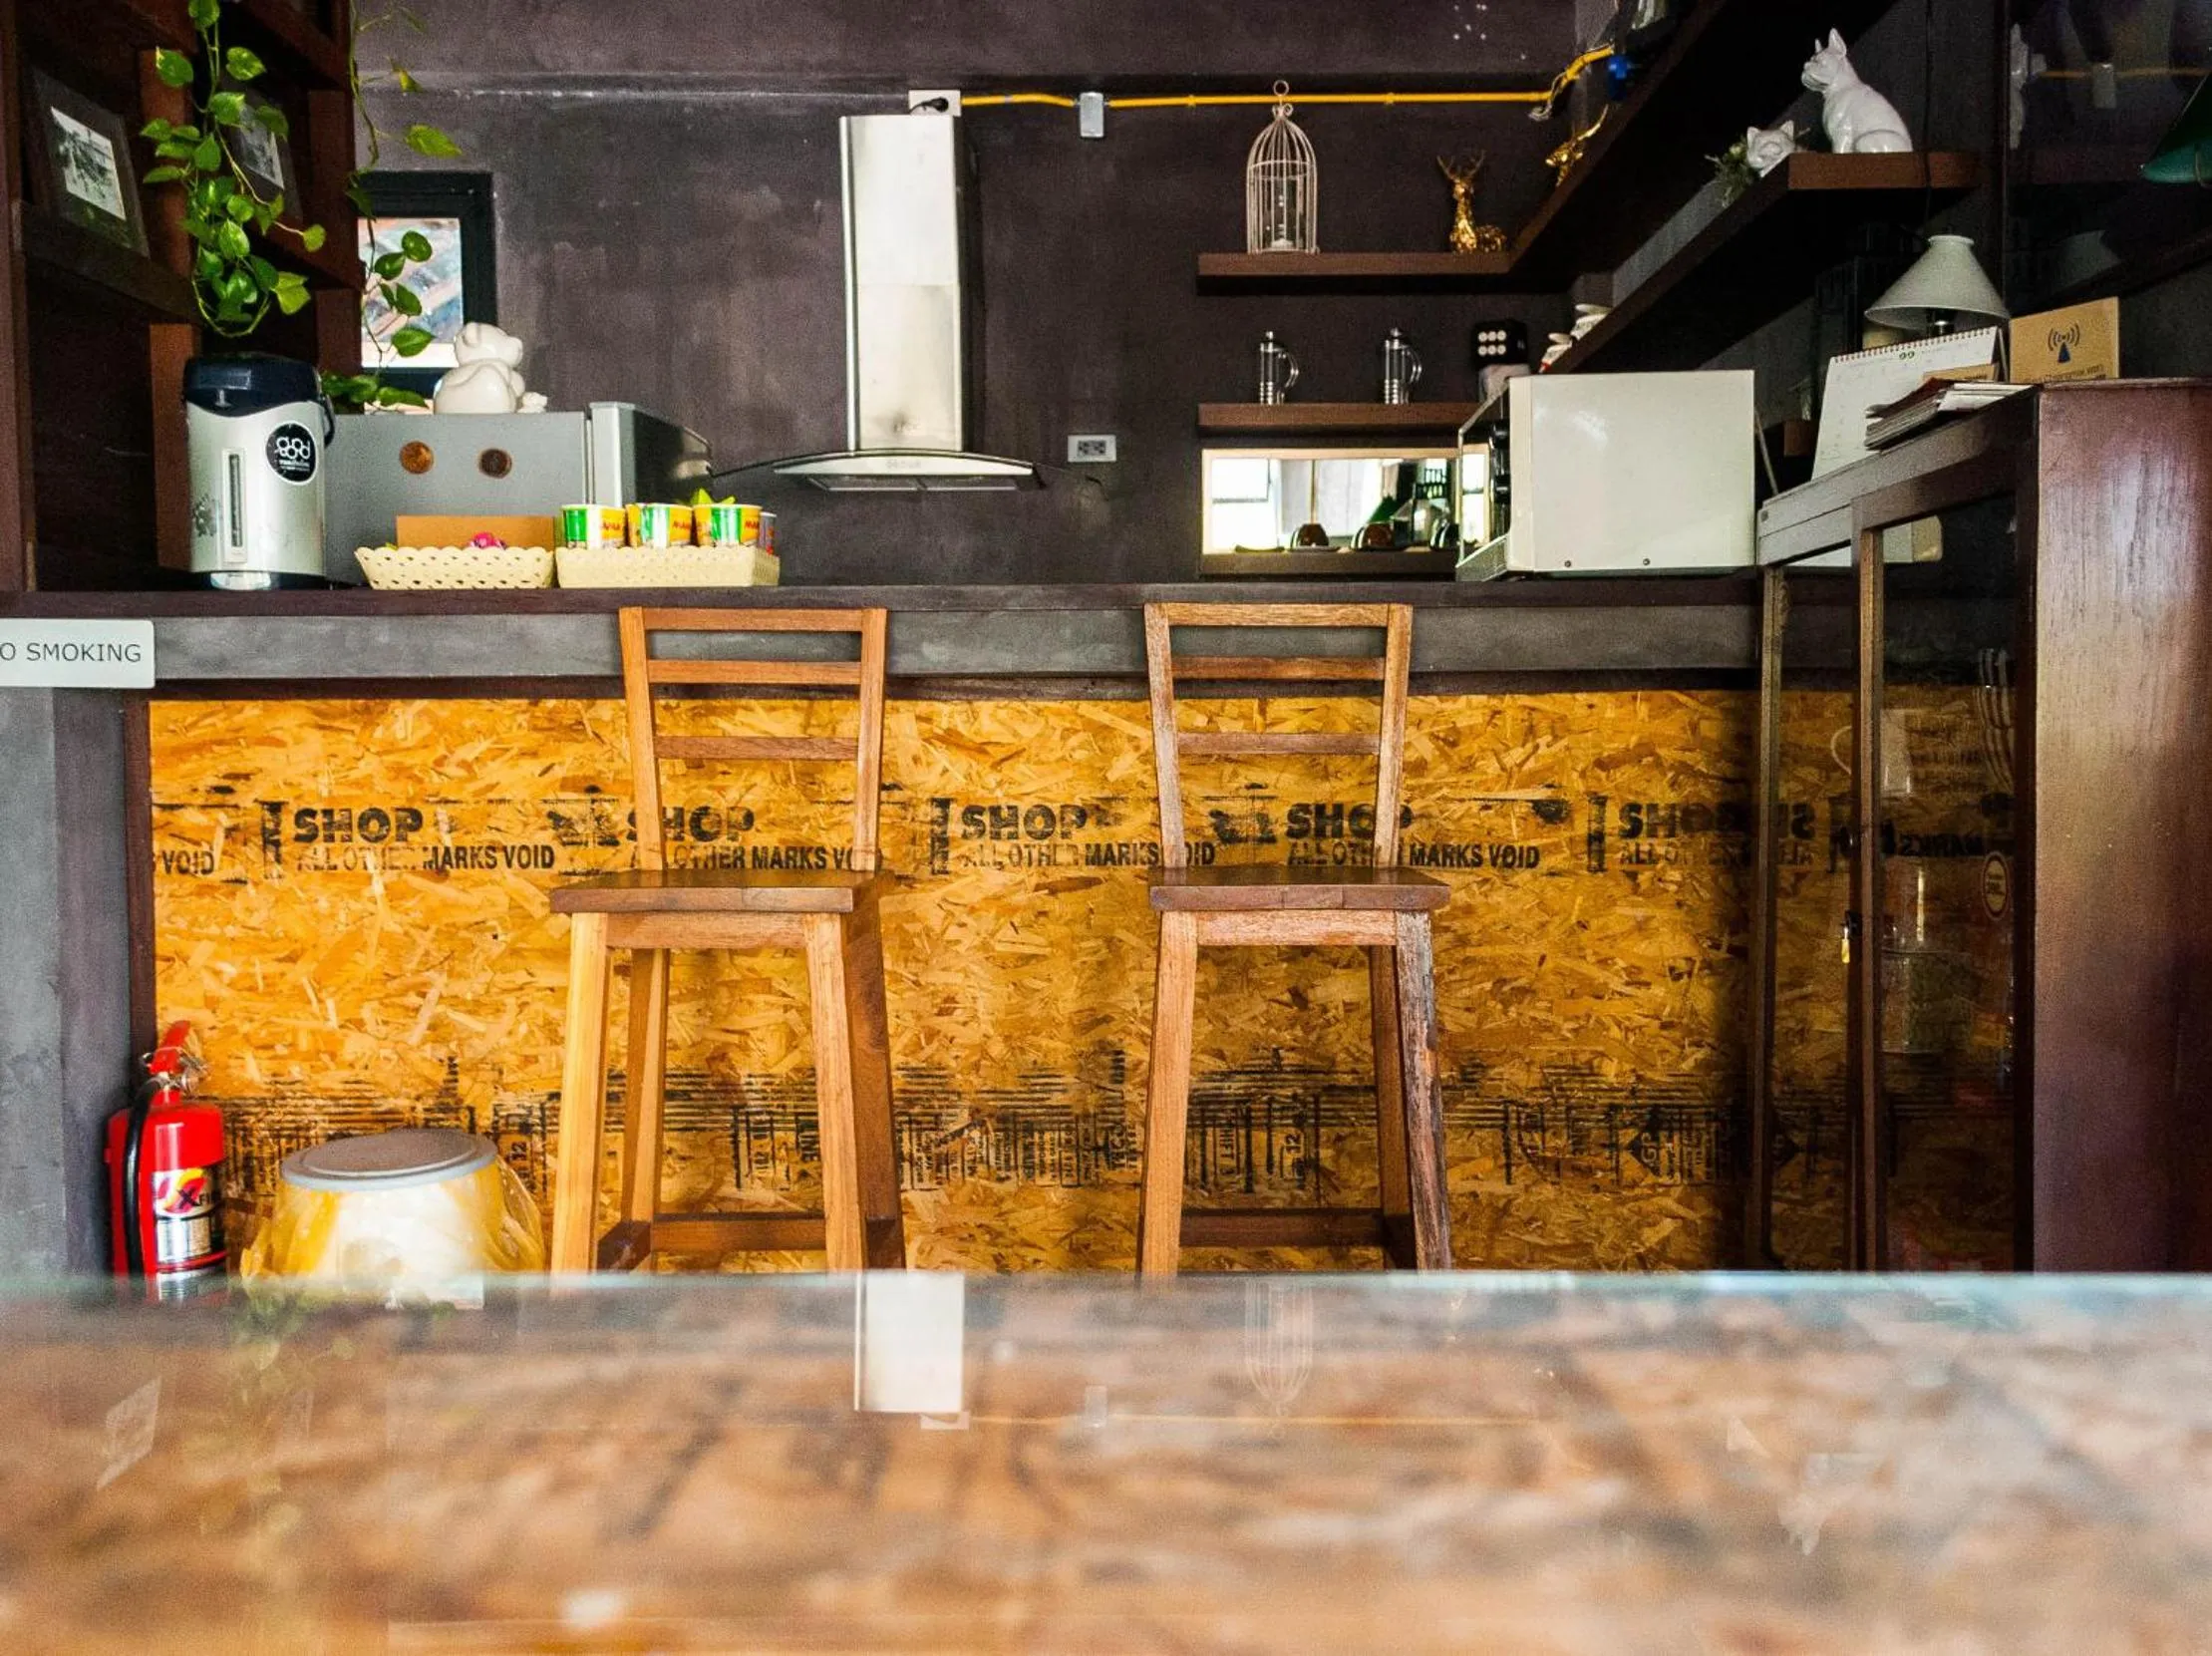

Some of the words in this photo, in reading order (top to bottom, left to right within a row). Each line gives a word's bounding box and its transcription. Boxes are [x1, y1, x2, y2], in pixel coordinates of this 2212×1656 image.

[0, 642, 17, 661] O
[26, 642, 142, 663] SMOKING
[293, 807, 424, 843] SHOP
[960, 805, 1089, 840] SHOP
[161, 849, 214, 875] VOID
[423, 846, 498, 870] MARKS
[502, 844, 555, 869] VOID
[674, 844, 747, 869] OTHER
[752, 845, 827, 869] MARKS
[1085, 841, 1159, 866] MARKS
[1288, 841, 1328, 866] ALL
[1410, 843, 1483, 867] MARKS
[1488, 844, 1540, 868] VOID
